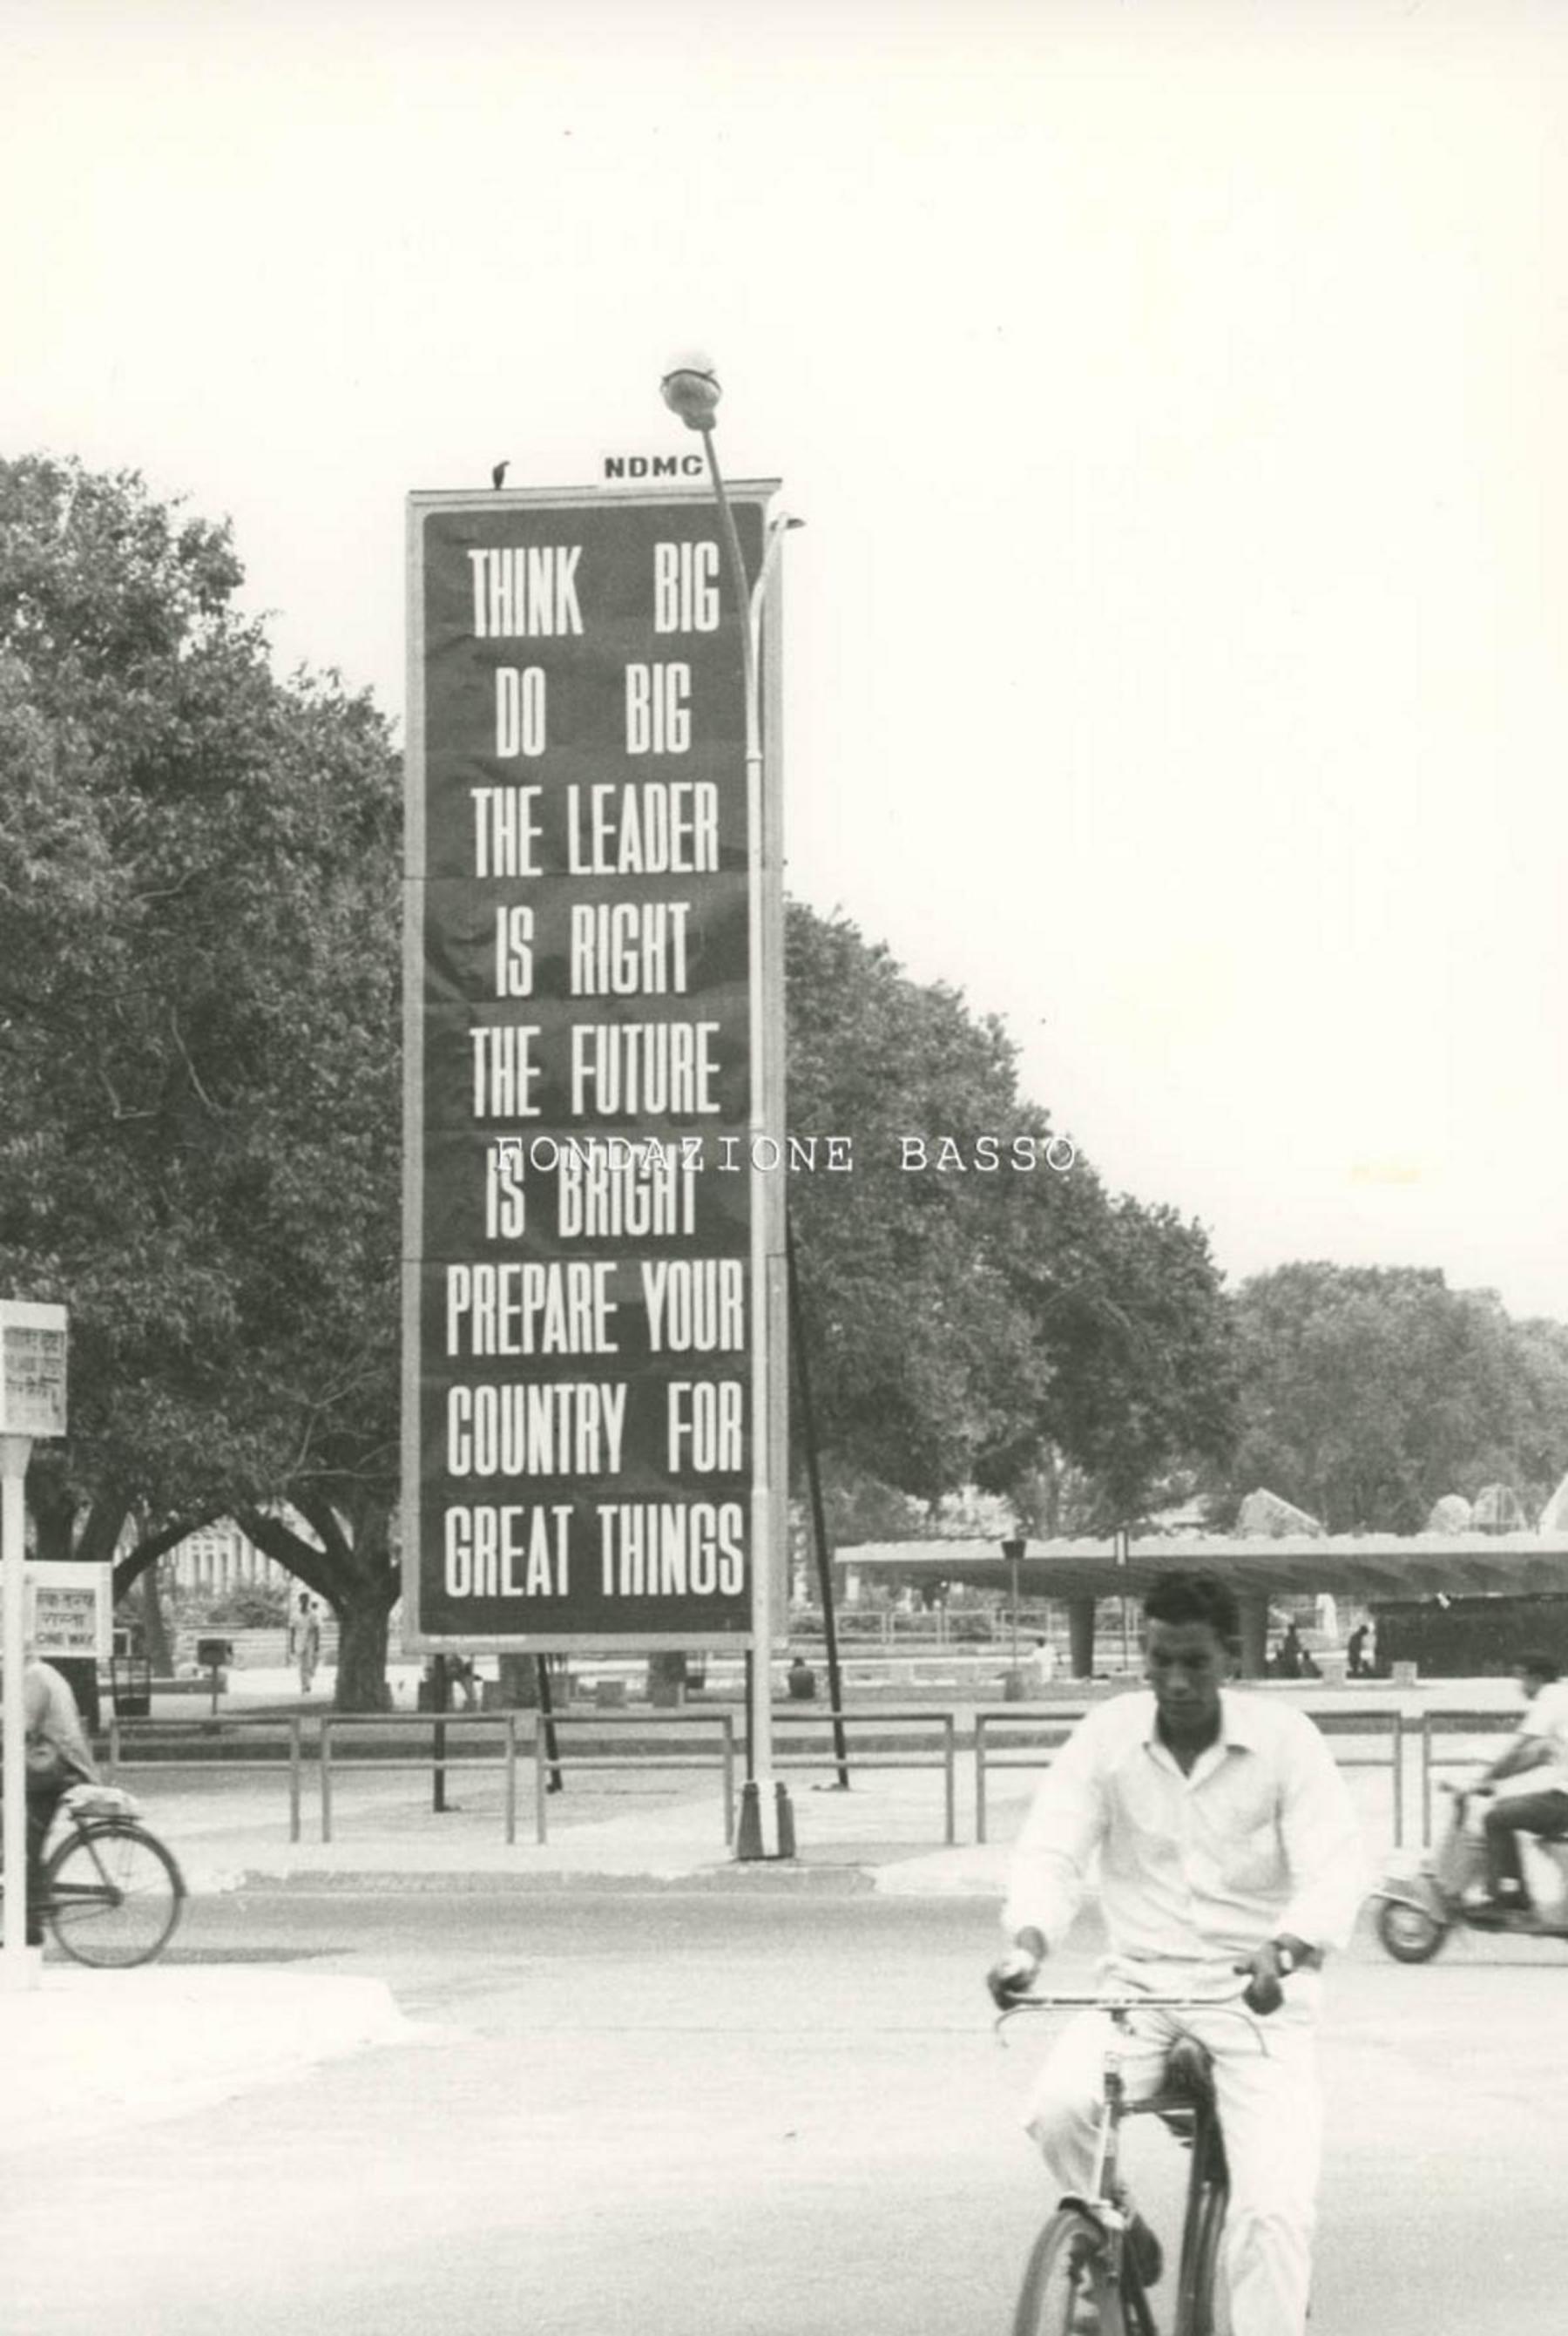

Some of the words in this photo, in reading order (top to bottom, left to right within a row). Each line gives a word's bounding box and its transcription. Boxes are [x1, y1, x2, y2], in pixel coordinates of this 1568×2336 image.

[605, 455, 703, 478] NDMC
[466, 545, 585, 639] THINK
[653, 540, 720, 634] BIG
[495, 666, 546, 759] DO
[625, 661, 692, 755] BIG
[470, 785, 544, 878] THE
[567, 781, 720, 876] LEADER
[495, 905, 535, 997] IS
[571, 901, 692, 995] RIGHT
[469, 1025, 542, 1117] THE
[571, 1021, 720, 1115] FUTURE
[485, 1147, 525, 1239] IS
[558, 1143, 697, 1237] BRIGHT
[447, 1261, 618, 1356] PREPARE
[640, 1258, 744, 1351] YOUR
[448, 1383, 626, 1476] COUNTRY
[668, 1380, 743, 1473] FOR
[445, 1505, 574, 1597] GREAT
[597, 1502, 744, 1596] THINGS
